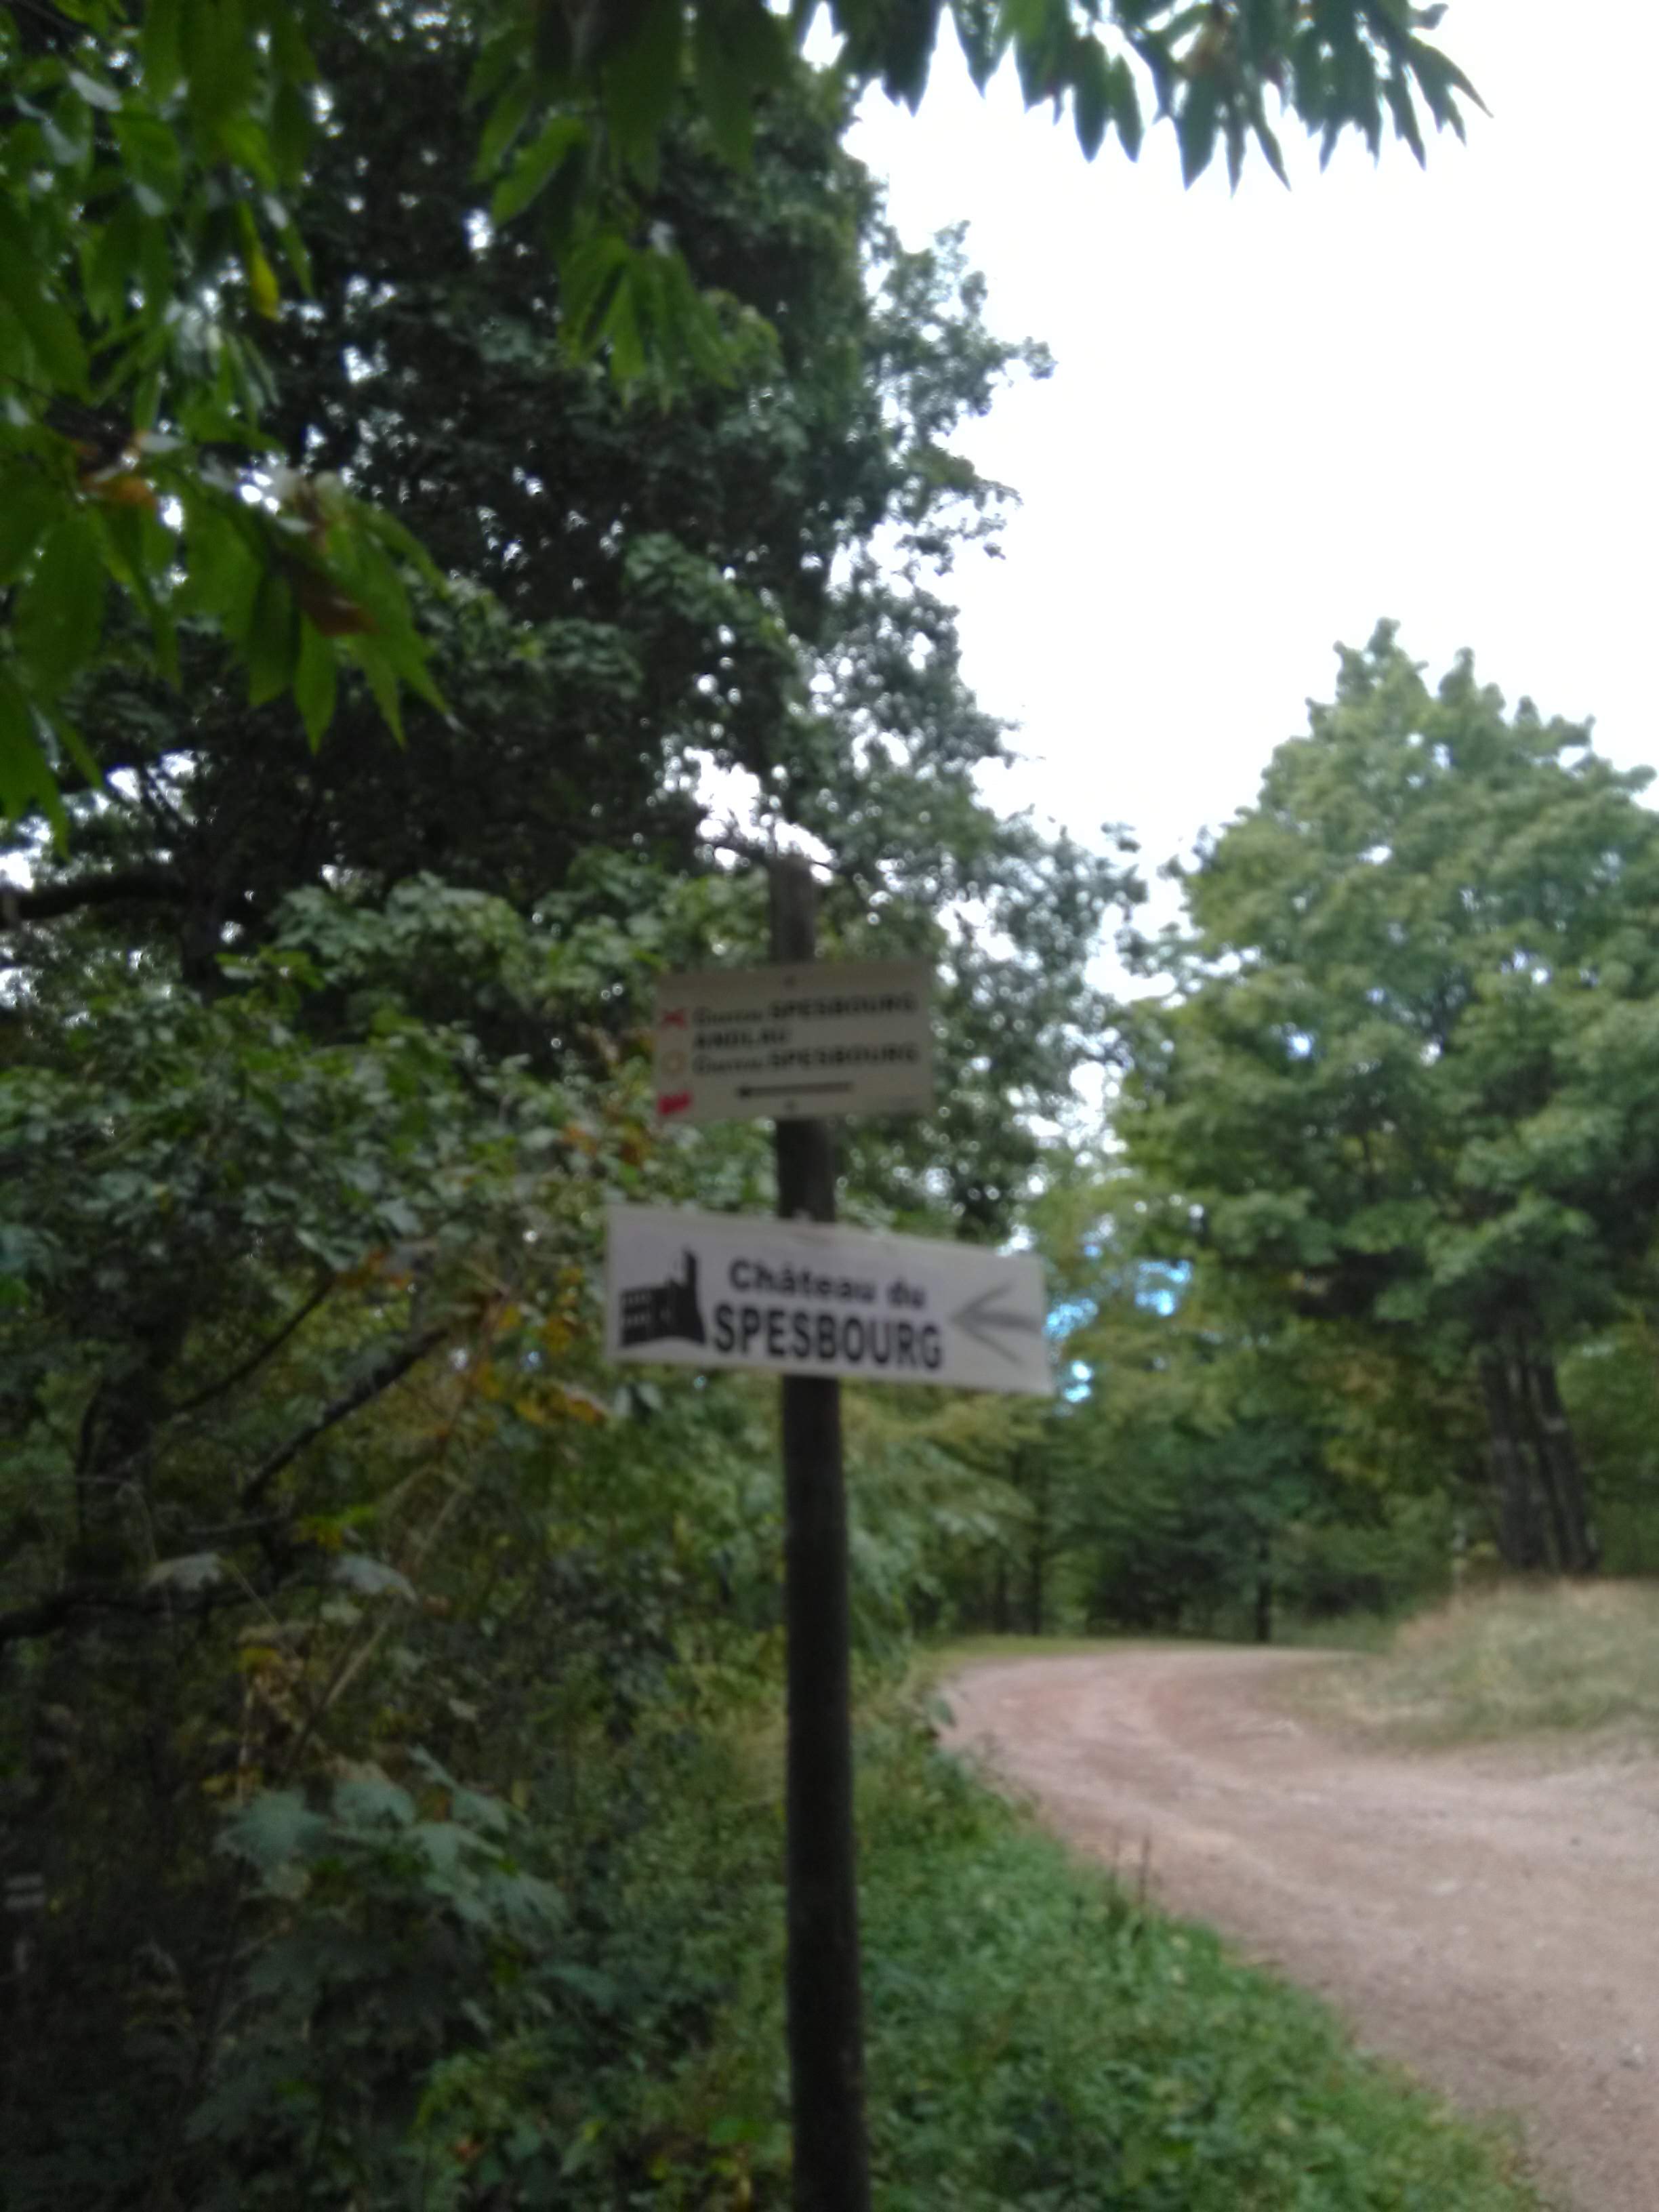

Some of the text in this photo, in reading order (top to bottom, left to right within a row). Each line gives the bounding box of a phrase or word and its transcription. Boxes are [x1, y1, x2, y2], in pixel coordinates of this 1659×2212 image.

[769, 993, 918, 1023] SPESBOURG
[769, 1043, 920, 1072] SPESBOURG
[727, 1257, 876, 1305] Château
[712, 1301, 945, 1373] SPESBOURG
